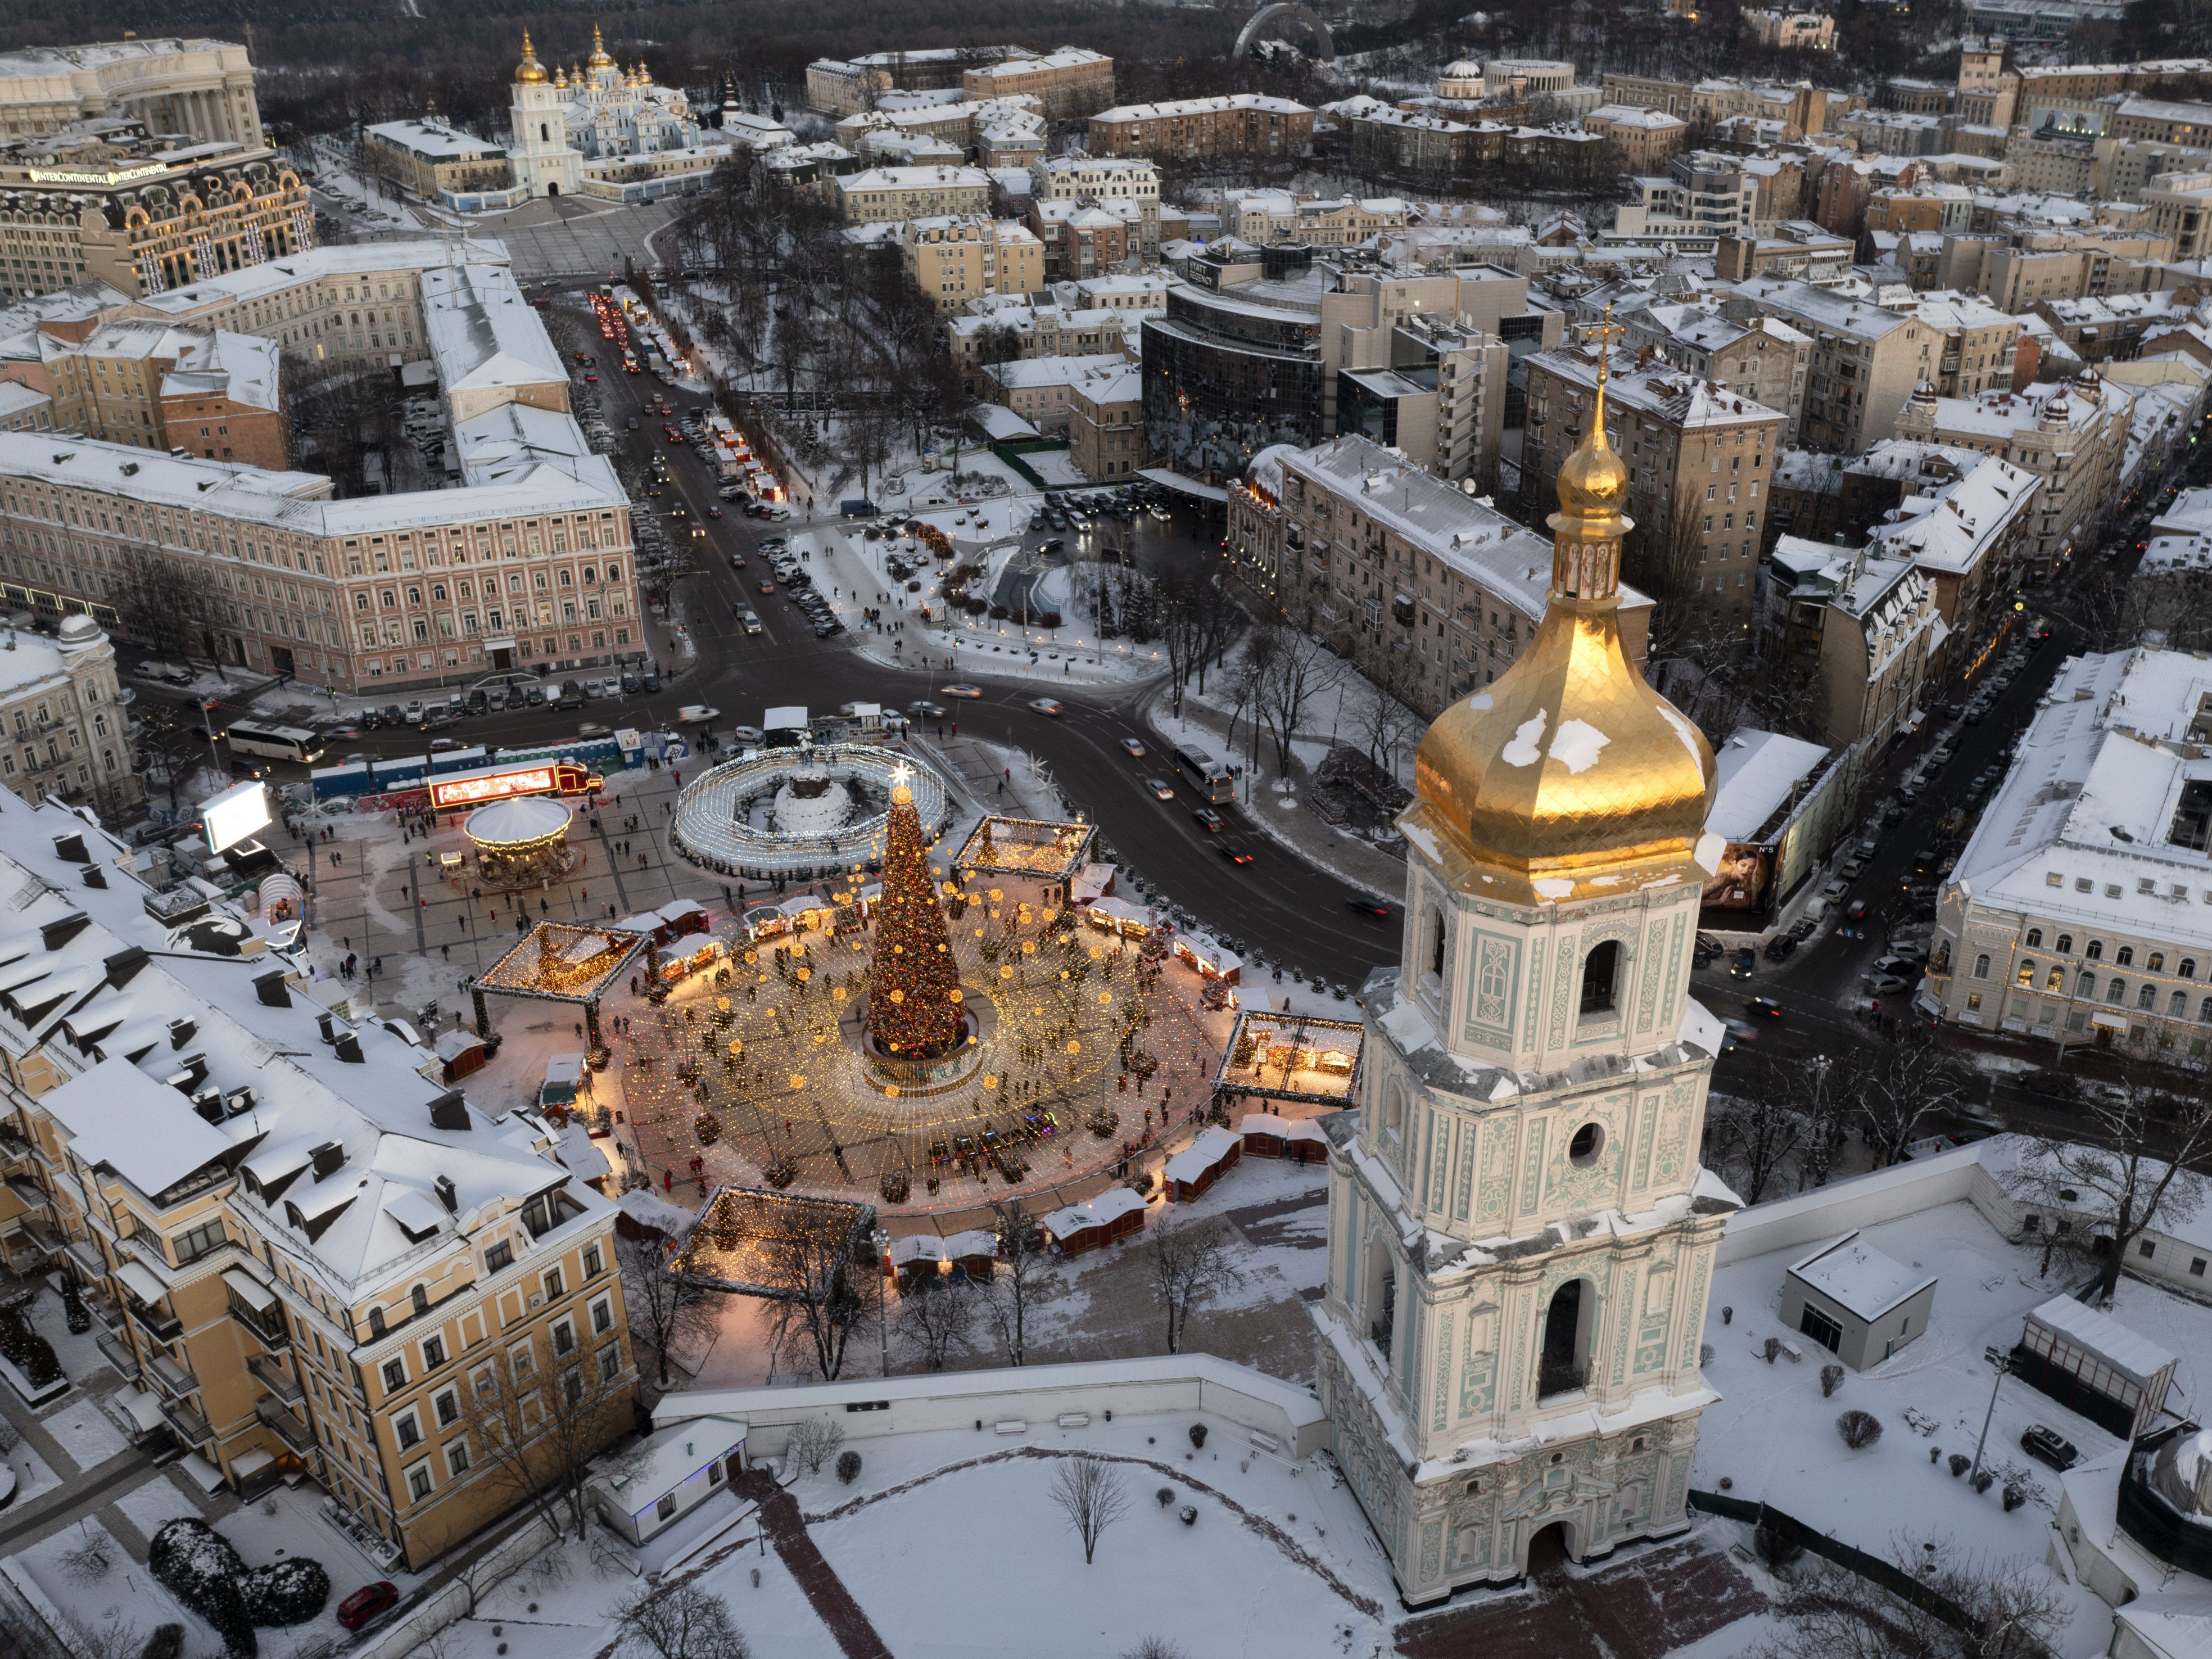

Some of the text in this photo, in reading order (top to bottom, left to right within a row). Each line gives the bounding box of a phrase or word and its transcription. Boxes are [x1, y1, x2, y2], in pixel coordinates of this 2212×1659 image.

[37, 171, 108, 184] INTERCONTINENTAL
[114, 163, 168, 183] INTERCONTINENTAL
[1189, 260, 1207, 274] HYATT
[1189, 270, 1213, 286] REGENCY
